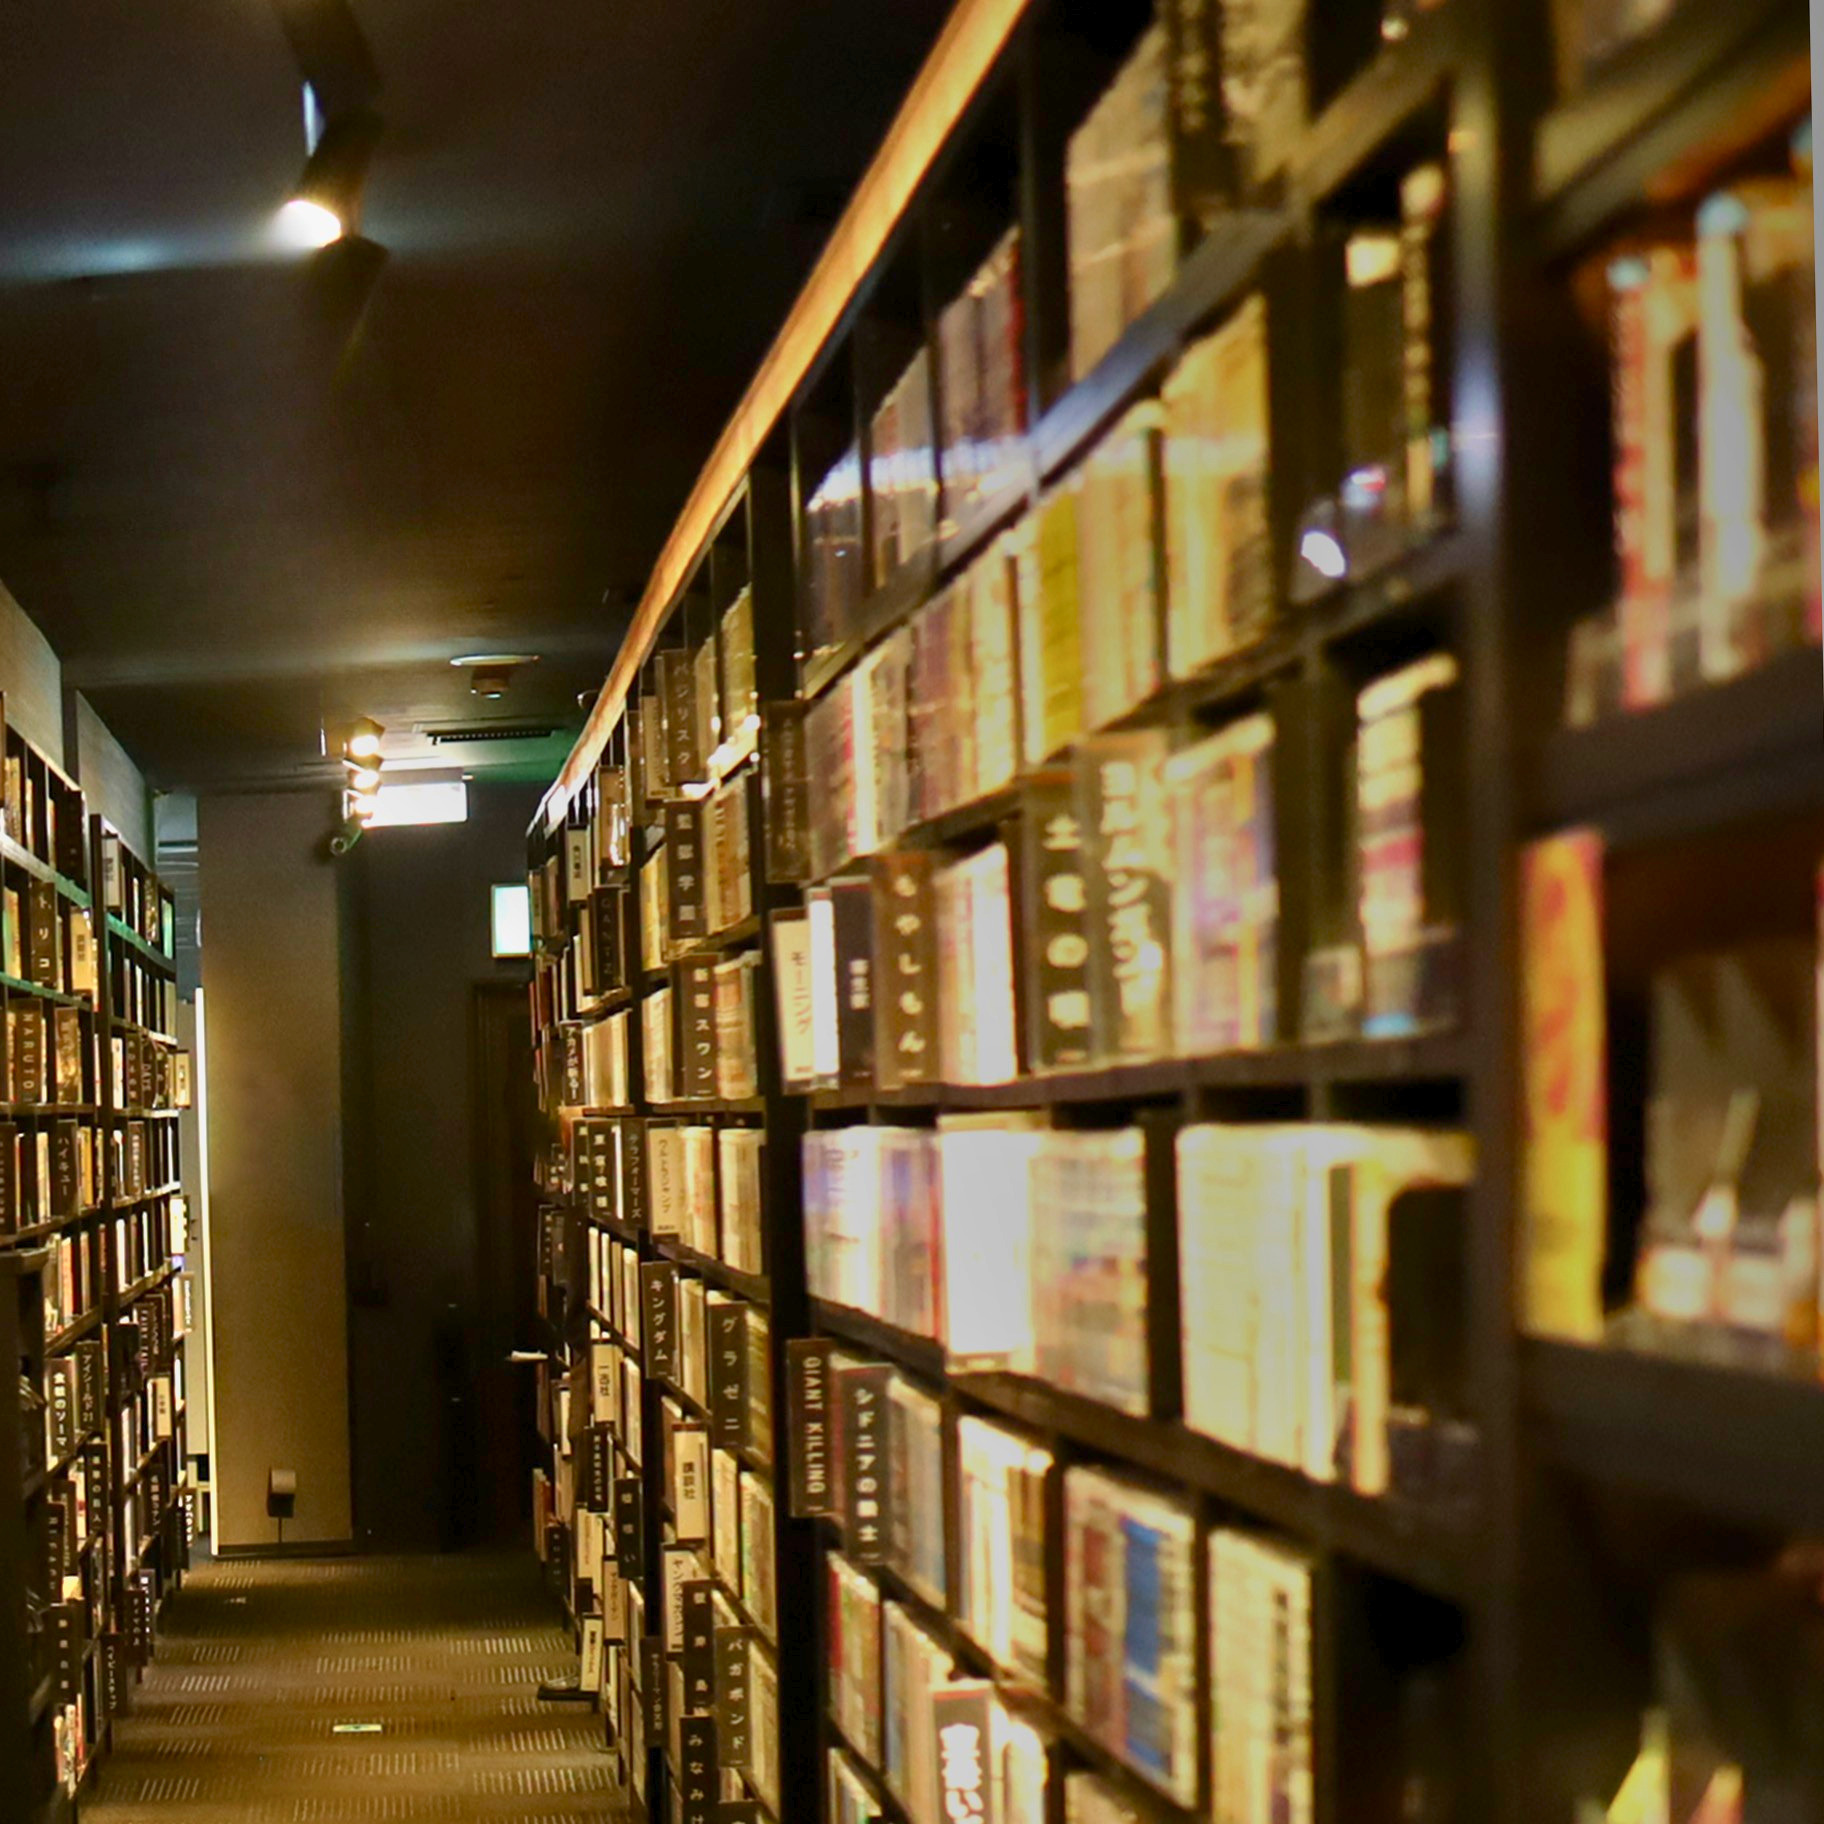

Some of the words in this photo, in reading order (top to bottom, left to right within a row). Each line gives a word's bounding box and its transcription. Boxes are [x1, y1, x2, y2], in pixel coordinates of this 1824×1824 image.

[672, 664, 692, 765] バジリスク
[39, 893, 51, 967] トリコ
[600, 897, 615, 977] GANTZ
[894, 872, 925, 1053] もやしもん
[23, 1014, 34, 1089] NARUTO
[650, 1280, 669, 1362] キングダム
[53, 1372, 67, 1447] 食戟のソーマ
[723, 1316, 741, 1431] グラゼニ
[803, 1357, 822, 1410] GIANT
[806, 1424, 826, 1495] KILLING
[856, 1388, 878, 1542] シドニアの騎士
[728, 1639, 745, 1750] バガボンド
